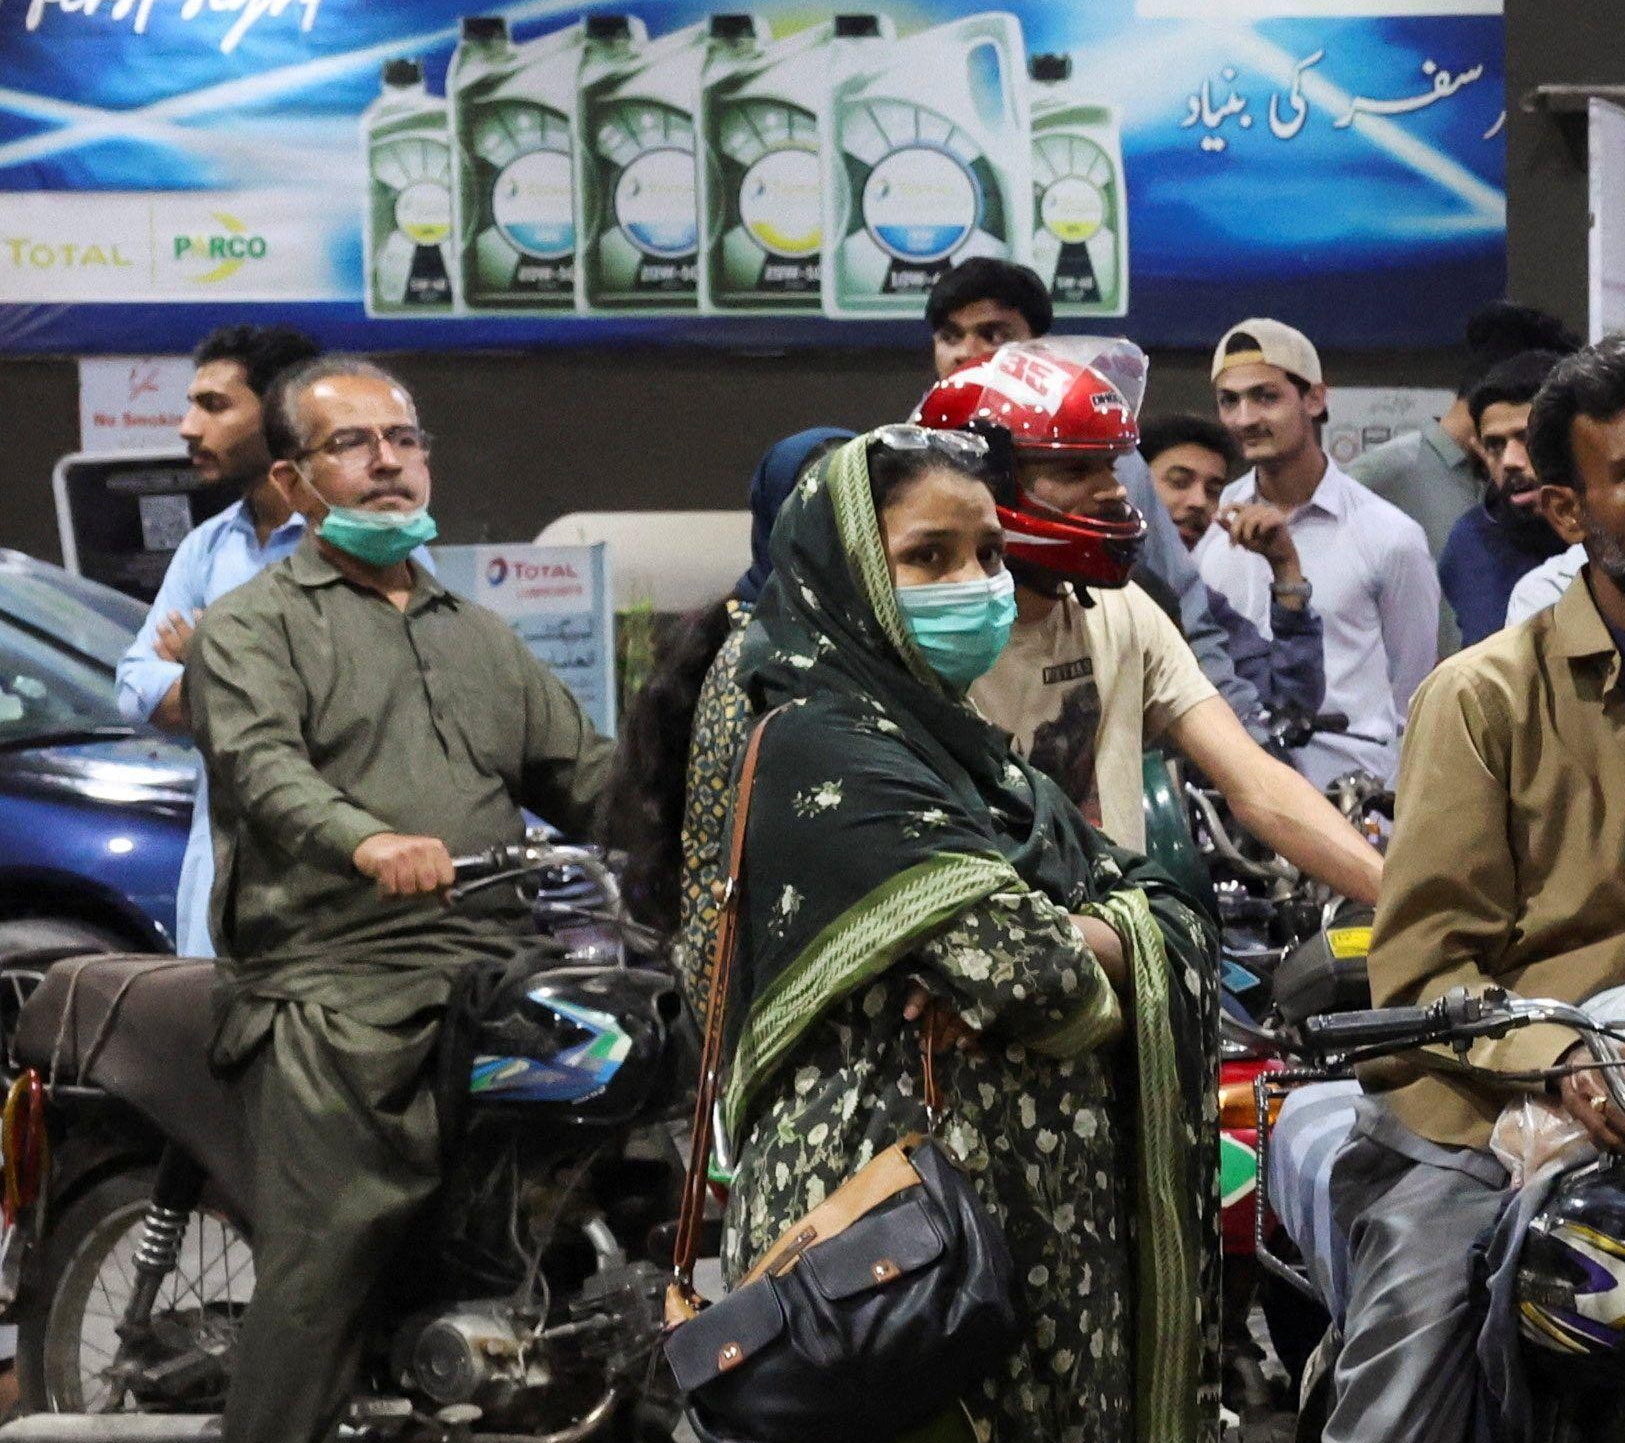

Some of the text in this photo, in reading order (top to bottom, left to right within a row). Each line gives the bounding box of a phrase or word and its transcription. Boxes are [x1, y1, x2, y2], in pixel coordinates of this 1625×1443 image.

[1181, 66, 1253, 153] بنیاد
[1268, 48, 1326, 140] کی
[1332, 59, 1484, 129] سفر
[5, 236, 135, 269] TOTAL
[173, 233, 268, 260] PARCO
[513, 563, 578, 580] TOTAL
